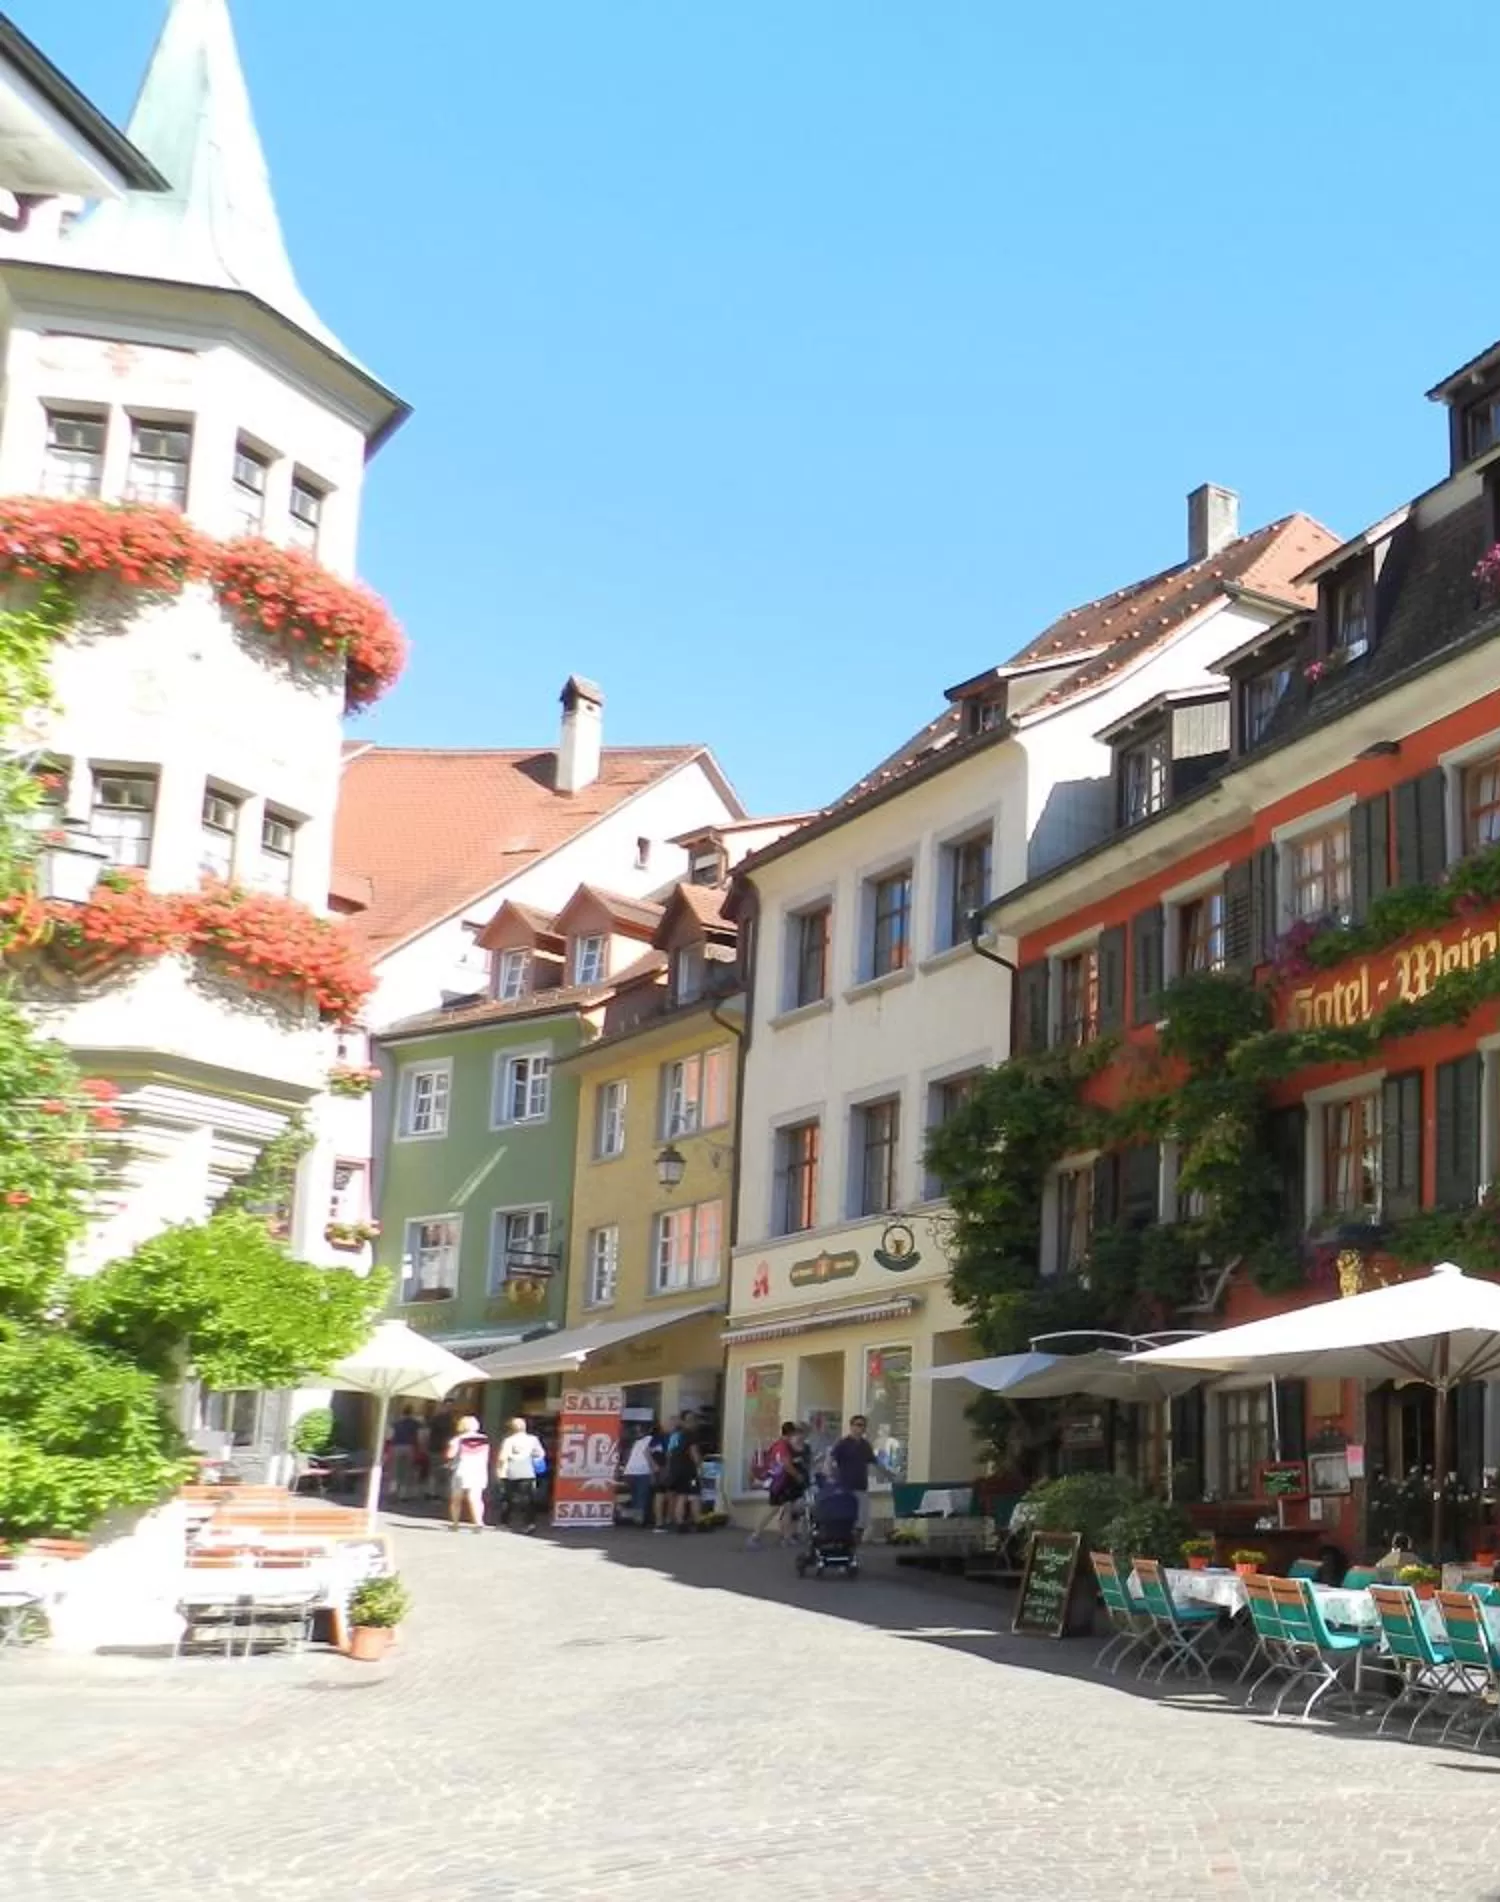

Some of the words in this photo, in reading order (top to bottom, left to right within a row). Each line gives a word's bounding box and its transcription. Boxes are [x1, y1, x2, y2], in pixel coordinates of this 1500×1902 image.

[1288, 963, 1373, 1030] Hotel
[565, 1394, 619, 1412] SALE
[560, 1432, 620, 1468] 50%
[557, 1503, 611, 1519] SALE
